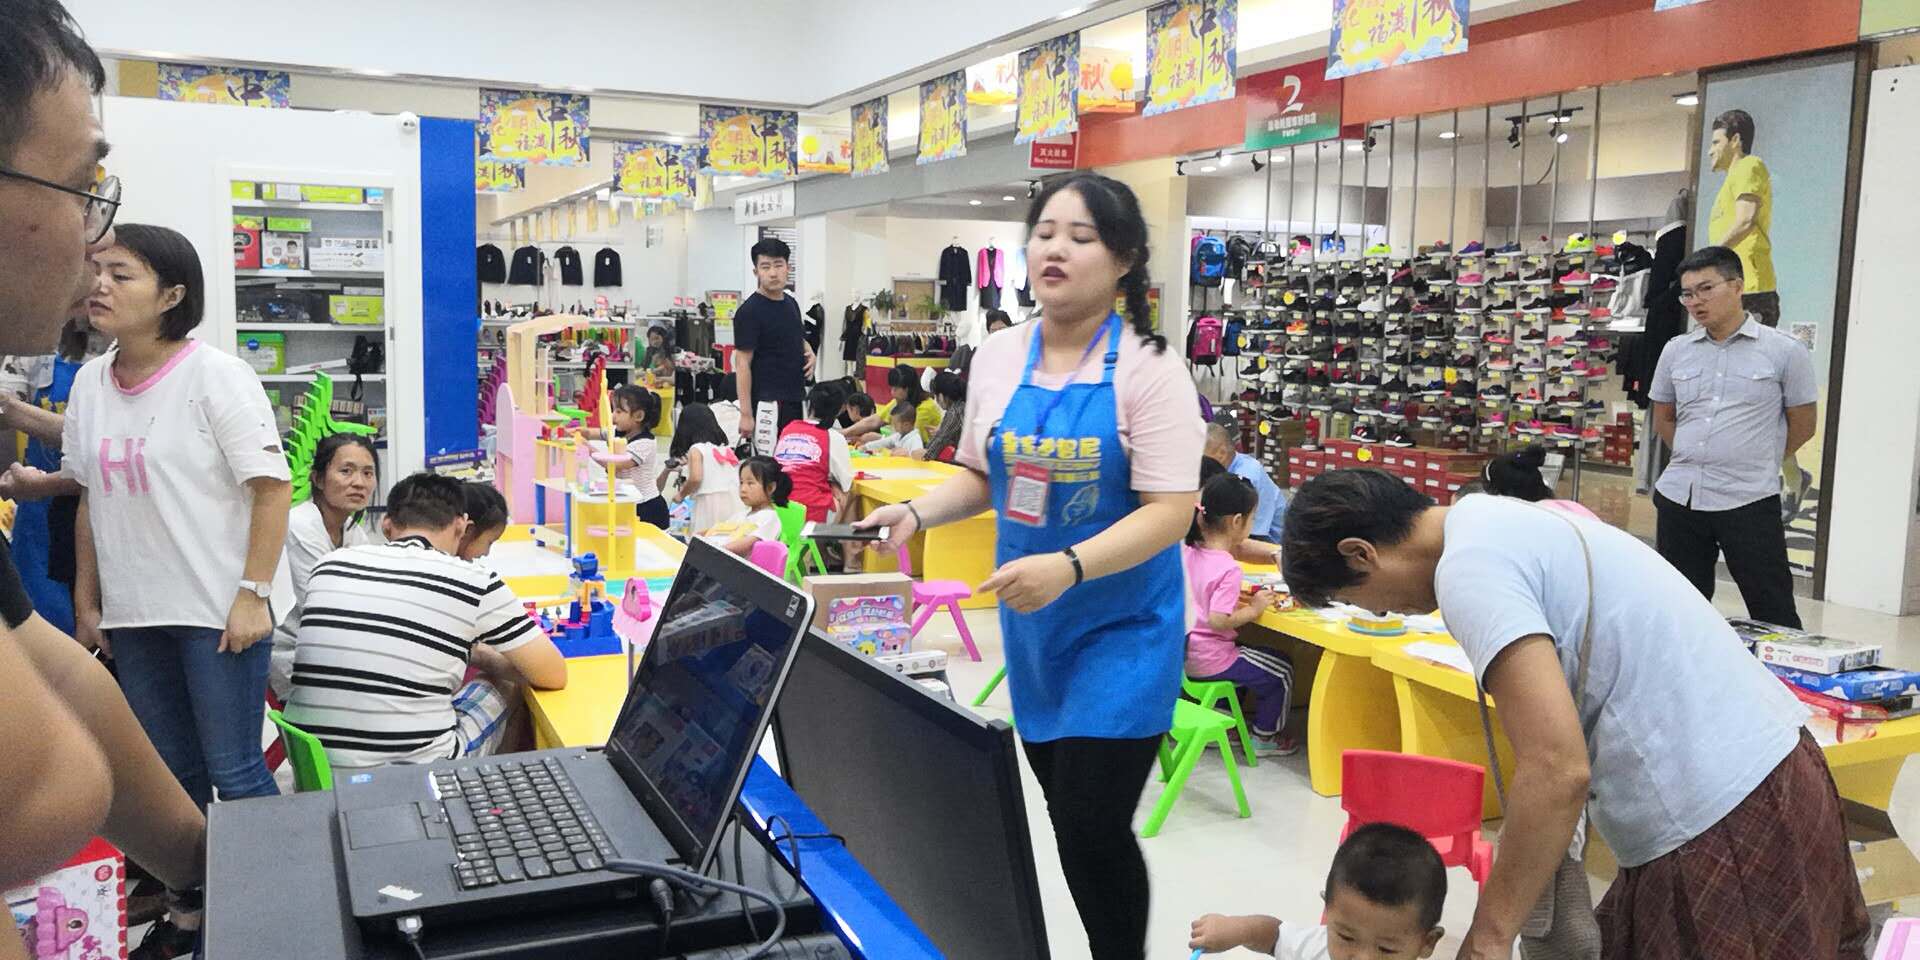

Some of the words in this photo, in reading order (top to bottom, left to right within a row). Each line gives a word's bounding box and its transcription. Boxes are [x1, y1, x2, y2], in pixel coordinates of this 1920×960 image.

[1080, 63, 1105, 92] 秋
[1281, 75, 1304, 116] 2
[98, 437, 151, 495] Hi
